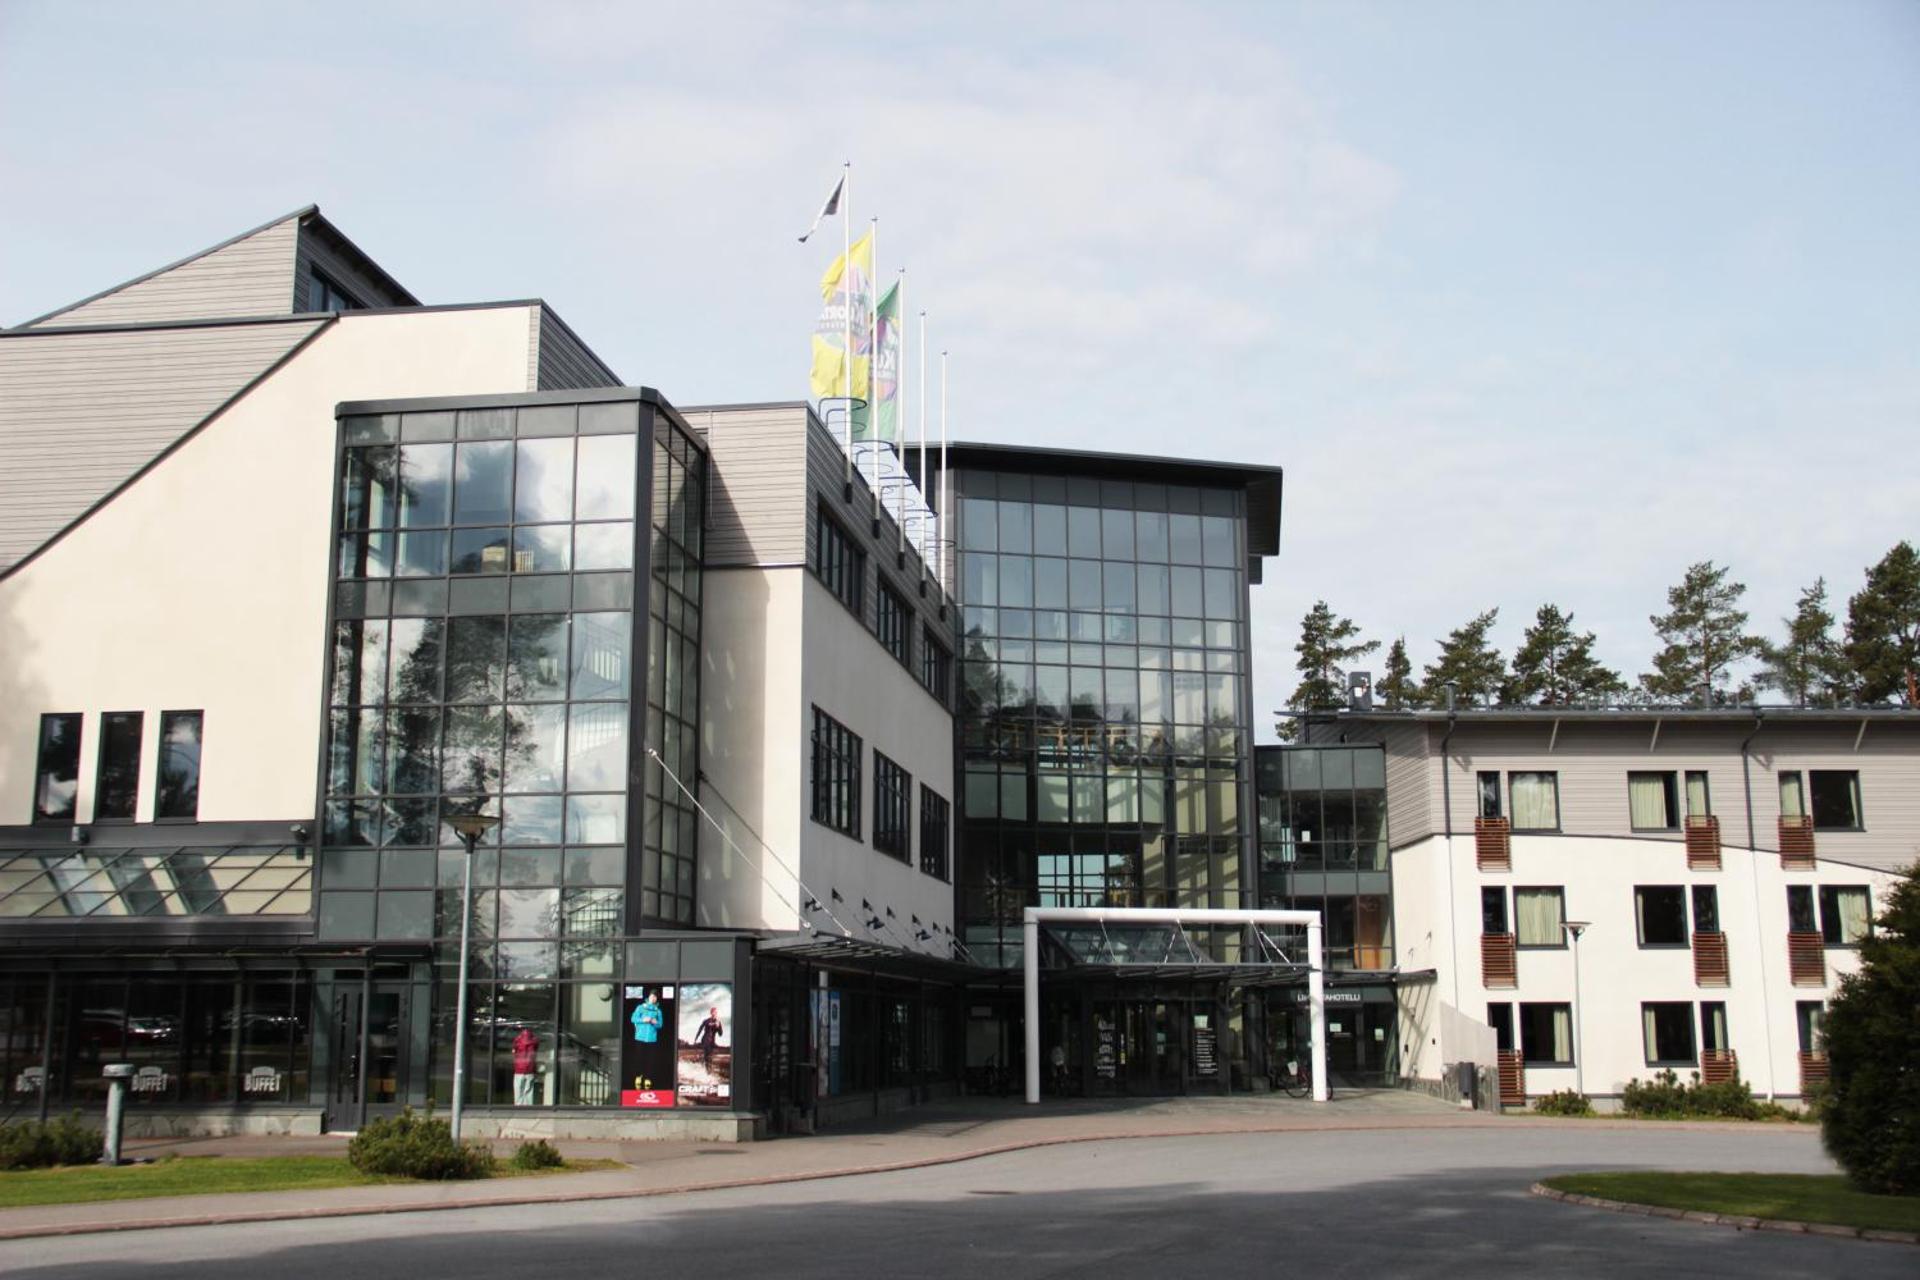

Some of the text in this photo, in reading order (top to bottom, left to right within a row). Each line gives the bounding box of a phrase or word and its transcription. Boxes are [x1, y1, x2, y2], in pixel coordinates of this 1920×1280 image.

[131, 1073, 168, 1091] BUFFET
[244, 1073, 281, 1091] BUFFET
[678, 1085, 709, 1093] CRAFT
